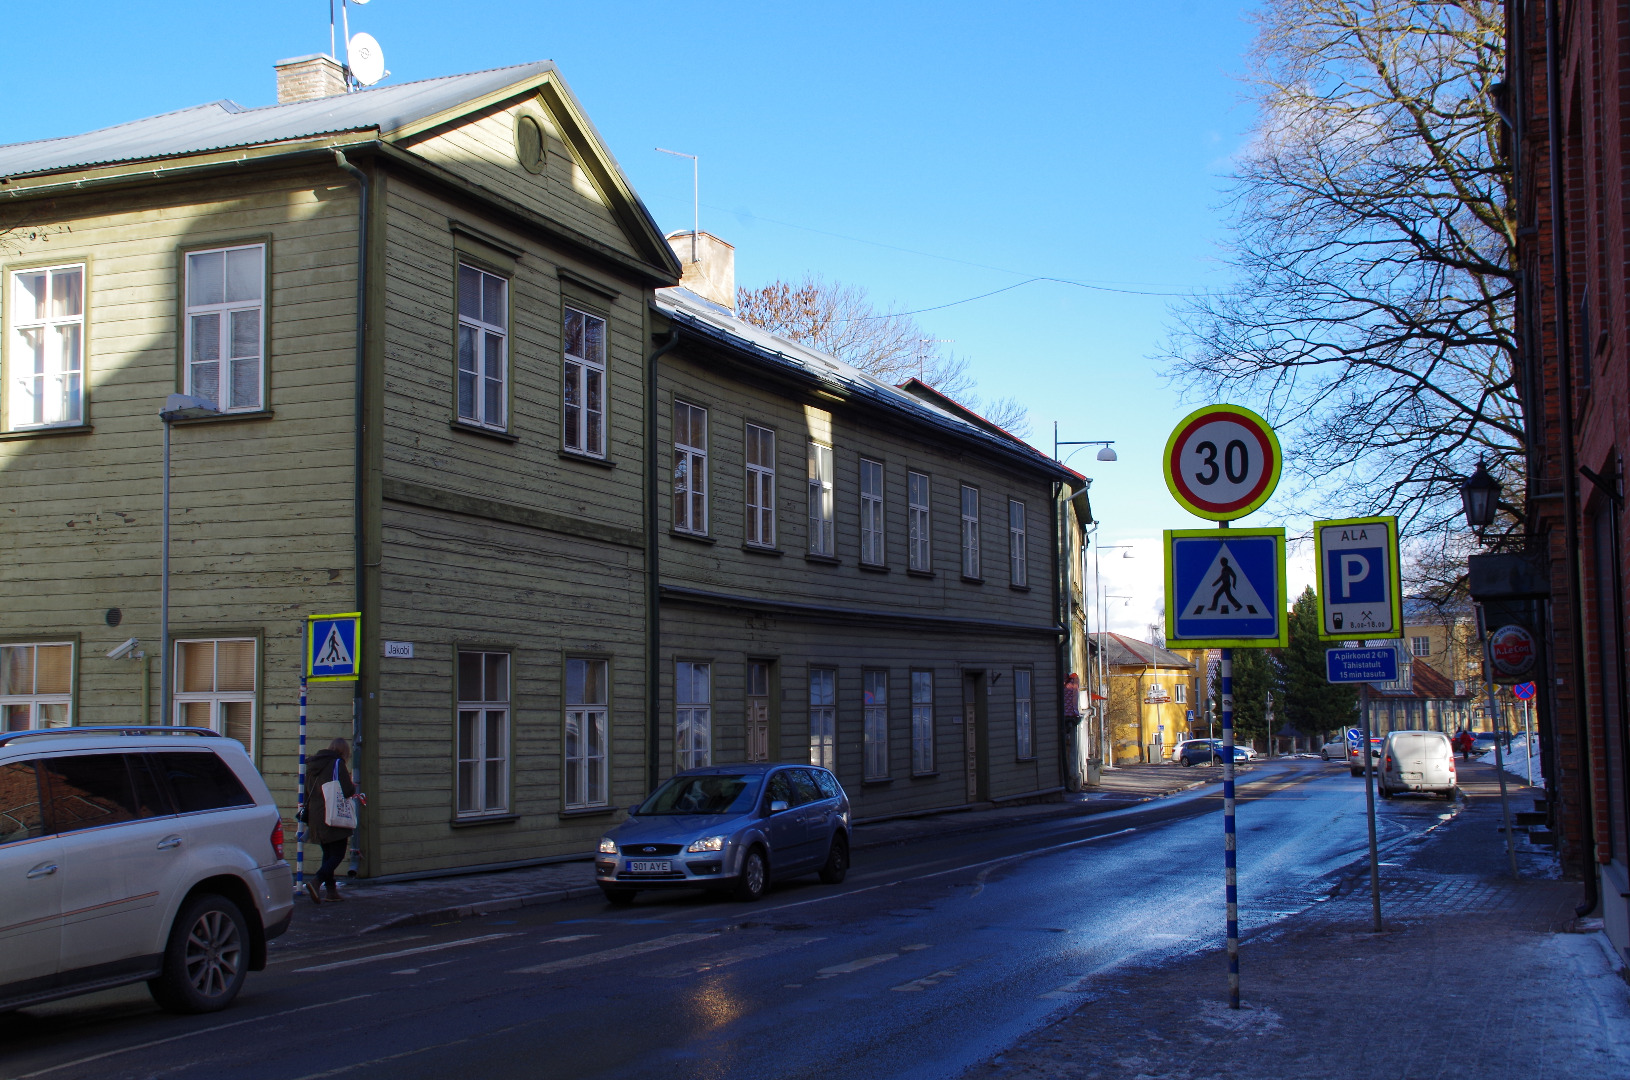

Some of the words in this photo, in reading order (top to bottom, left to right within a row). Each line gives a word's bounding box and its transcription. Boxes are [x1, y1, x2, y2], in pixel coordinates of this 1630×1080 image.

[1195, 439, 1248, 485] 30
[1341, 529, 1367, 541] ALA
[1341, 554, 1369, 598] P
[388, 645, 409, 655] Jakobi
[1341, 652, 1370, 661] piirkond
[1377, 651, 1388, 659] €/h
[1344, 661, 1381, 669] Tähistatult
[1363, 670, 1385, 678] tasuta
[633, 862, 646, 871] 901
[650, 862, 668, 870] AYE
